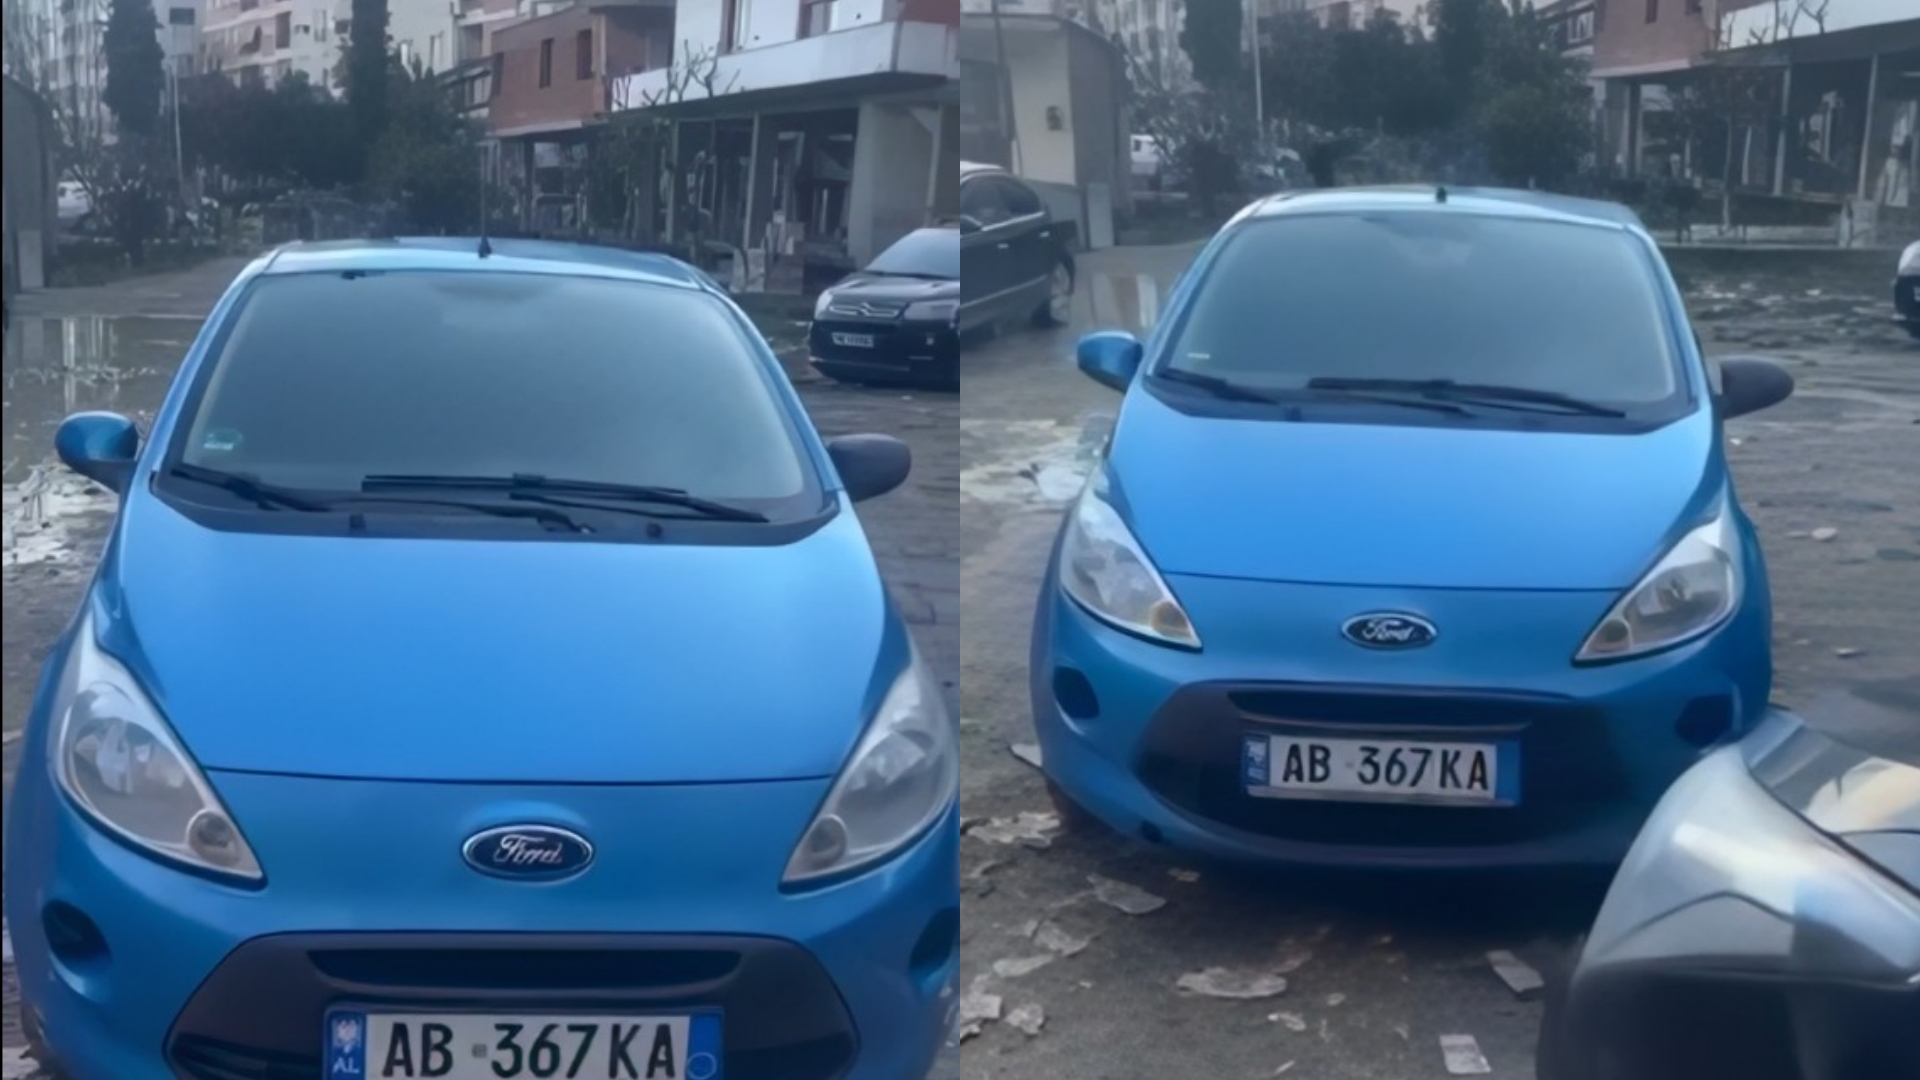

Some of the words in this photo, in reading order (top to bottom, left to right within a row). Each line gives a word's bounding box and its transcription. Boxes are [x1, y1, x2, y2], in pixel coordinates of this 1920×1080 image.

[1281, 743, 1332, 784] AB
[332, 1056, 360, 1074] AL
[381, 1022, 454, 1078] AB
